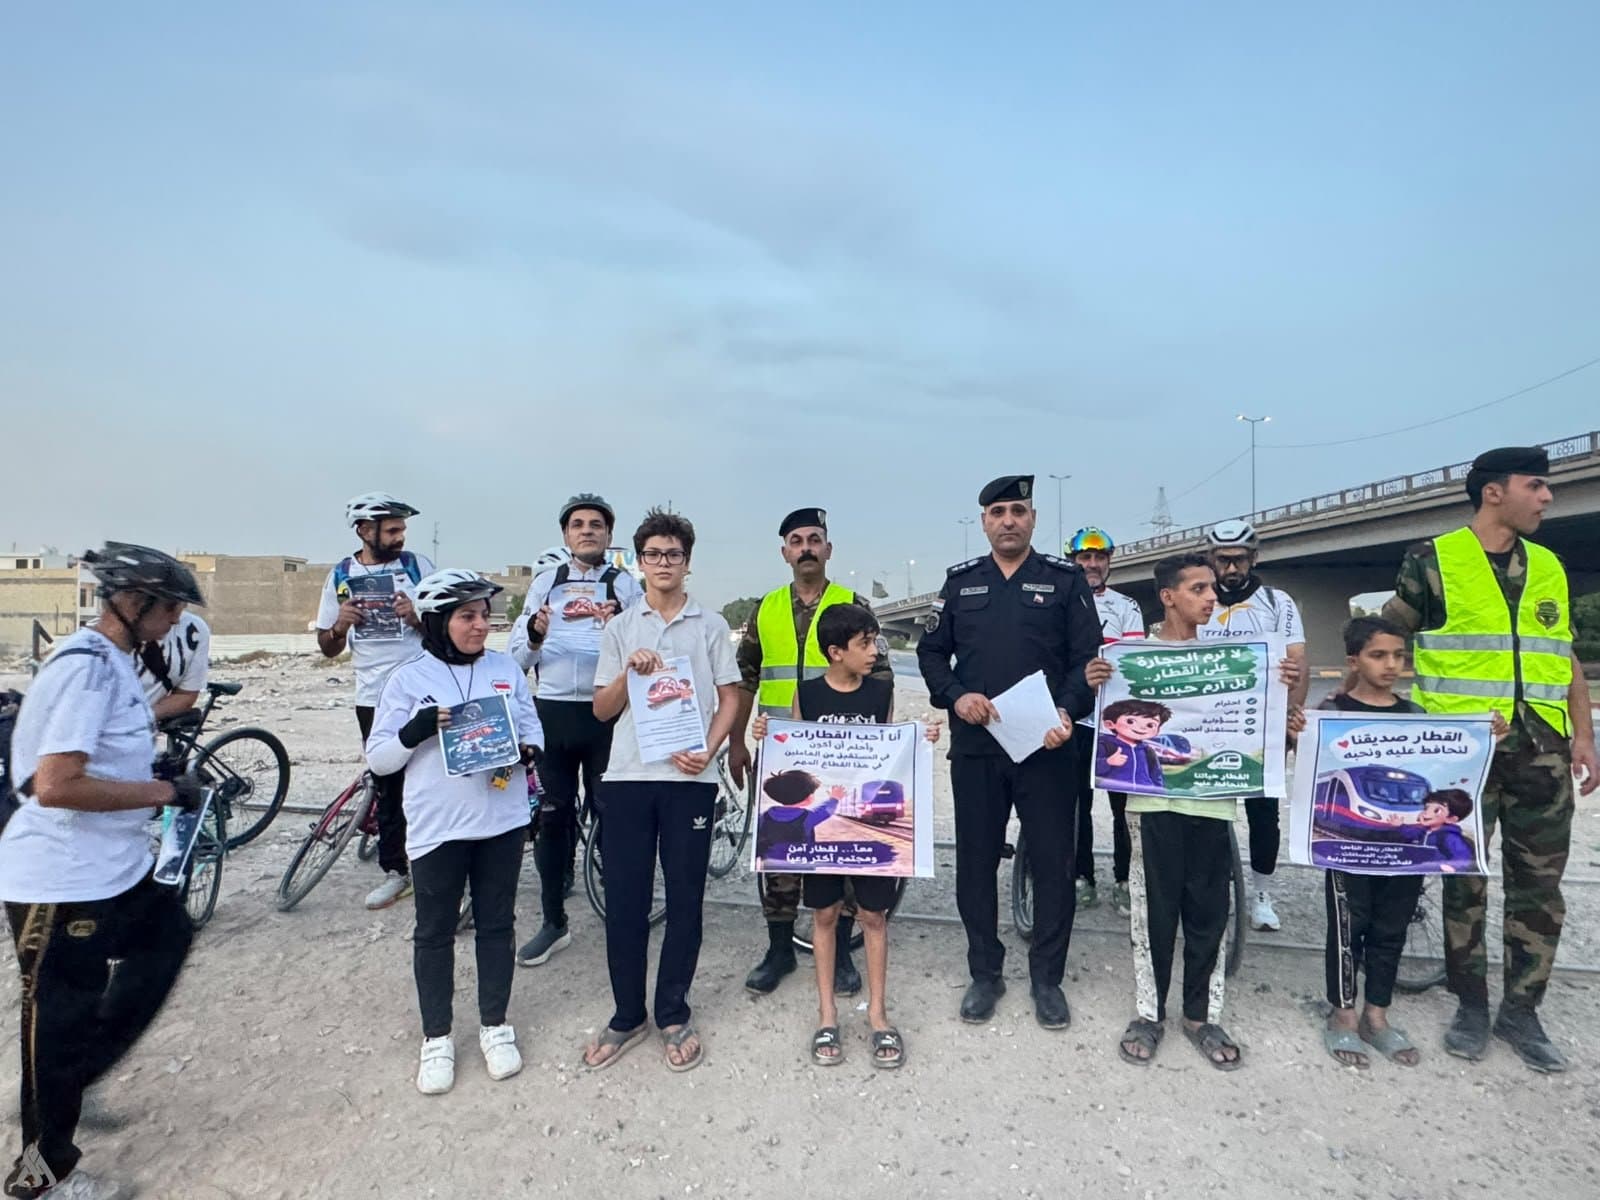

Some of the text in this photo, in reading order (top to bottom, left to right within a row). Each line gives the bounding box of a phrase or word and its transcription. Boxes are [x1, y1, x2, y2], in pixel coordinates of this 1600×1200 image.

[1136, 648, 1241, 669] لا ترم الحجارة
[1203, 663, 1229, 676] على
[1160, 684, 1198, 696] حبك
[1230, 678, 1247, 690] بل
[1140, 686, 1156, 696] له
[791, 729, 902, 742] أنا أحب القطارات
[1351, 731, 1462, 746] القطار صديقنا
[834, 740, 845, 750] أن
[1343, 748, 1382, 760] ونحبه
[1385, 746, 1416, 757] عليه
